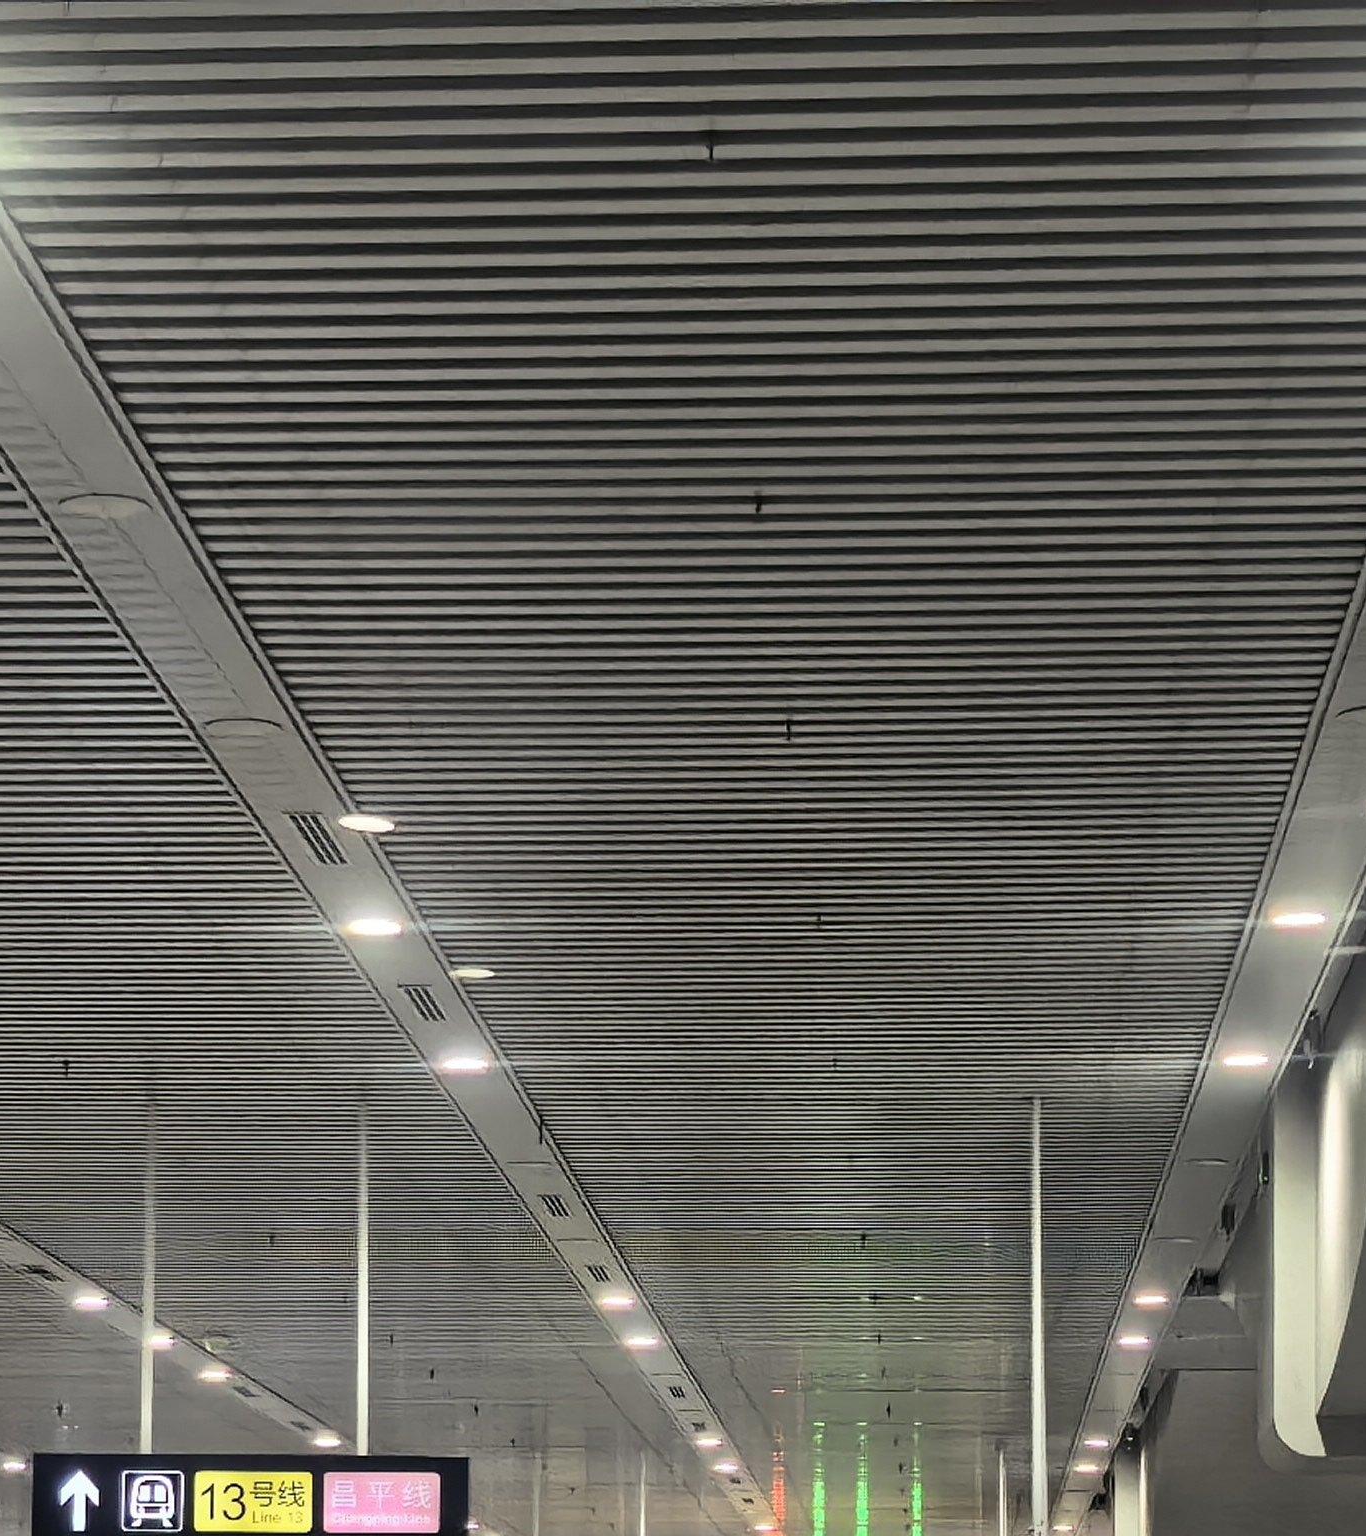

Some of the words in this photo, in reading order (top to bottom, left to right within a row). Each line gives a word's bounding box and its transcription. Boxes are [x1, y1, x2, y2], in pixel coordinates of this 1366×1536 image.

[200, 1479, 306, 1521] 13号线
[332, 1479, 432, 1510] 昌平线
